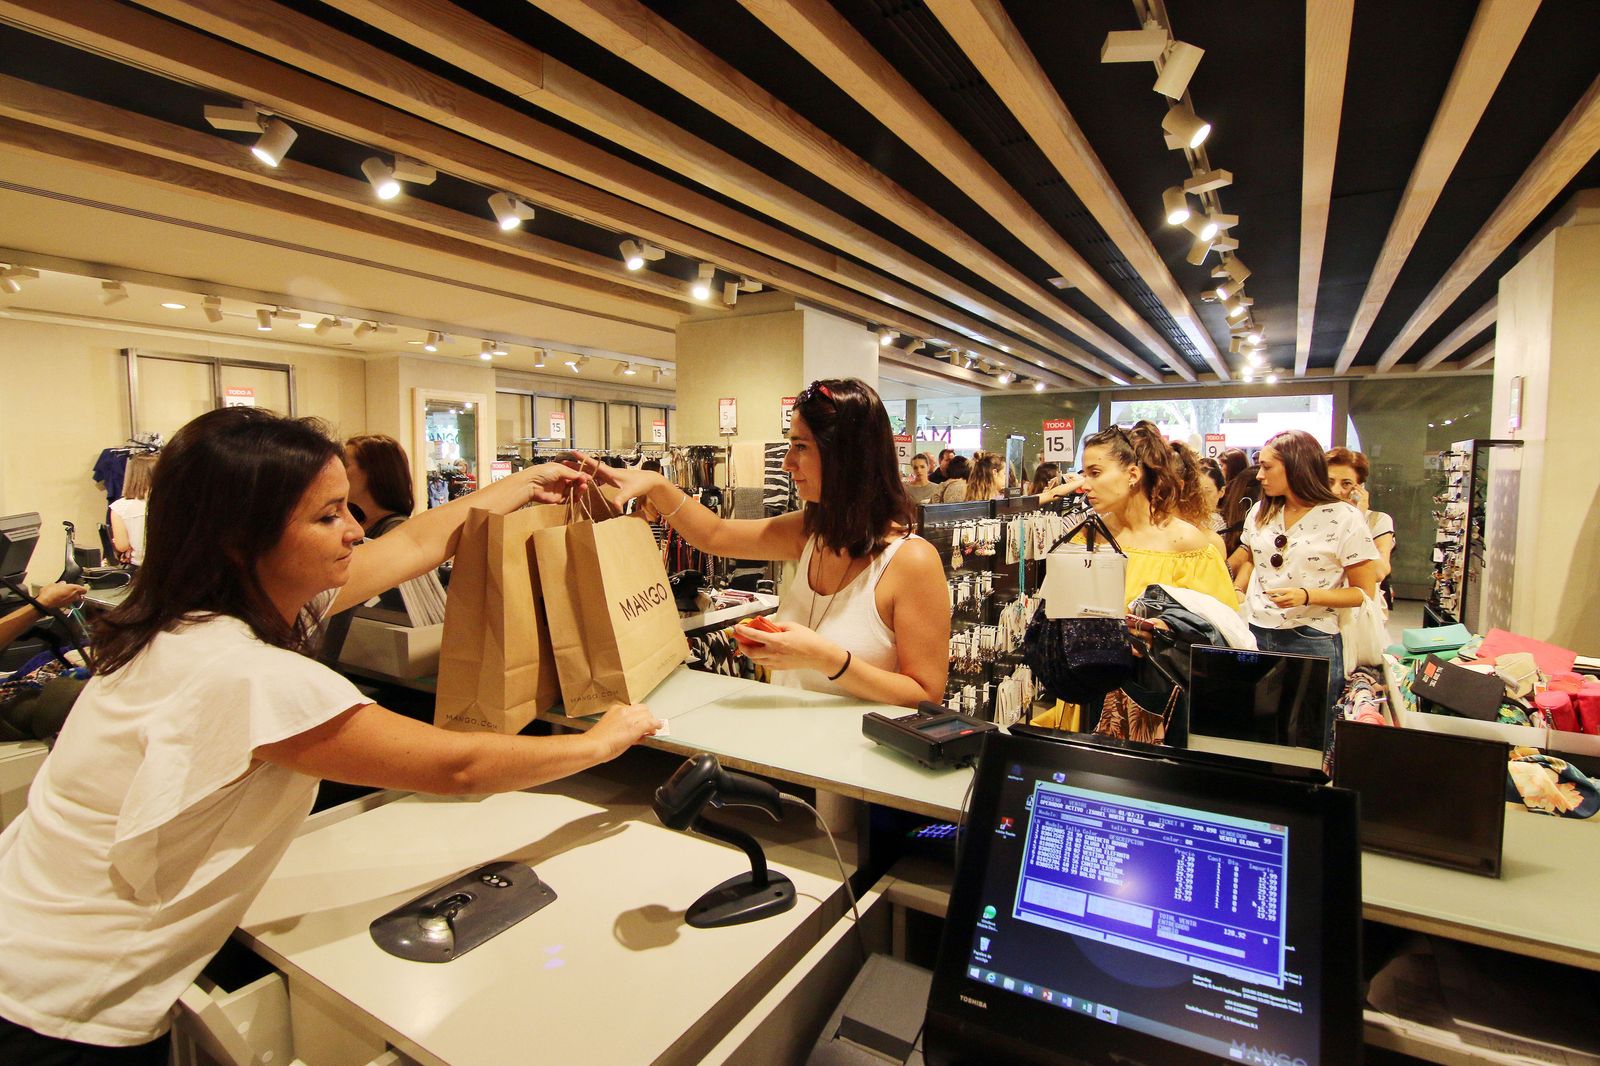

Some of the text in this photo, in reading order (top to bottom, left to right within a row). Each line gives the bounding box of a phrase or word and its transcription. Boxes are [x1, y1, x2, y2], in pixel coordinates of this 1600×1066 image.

[1046, 436, 1065, 452] 15
[1208, 445, 1218, 459] 9
[619, 582, 668, 621] MANGO
[445, 713, 499, 730] MANGO.COM
[960, 994, 988, 1009] TOSHIBA
